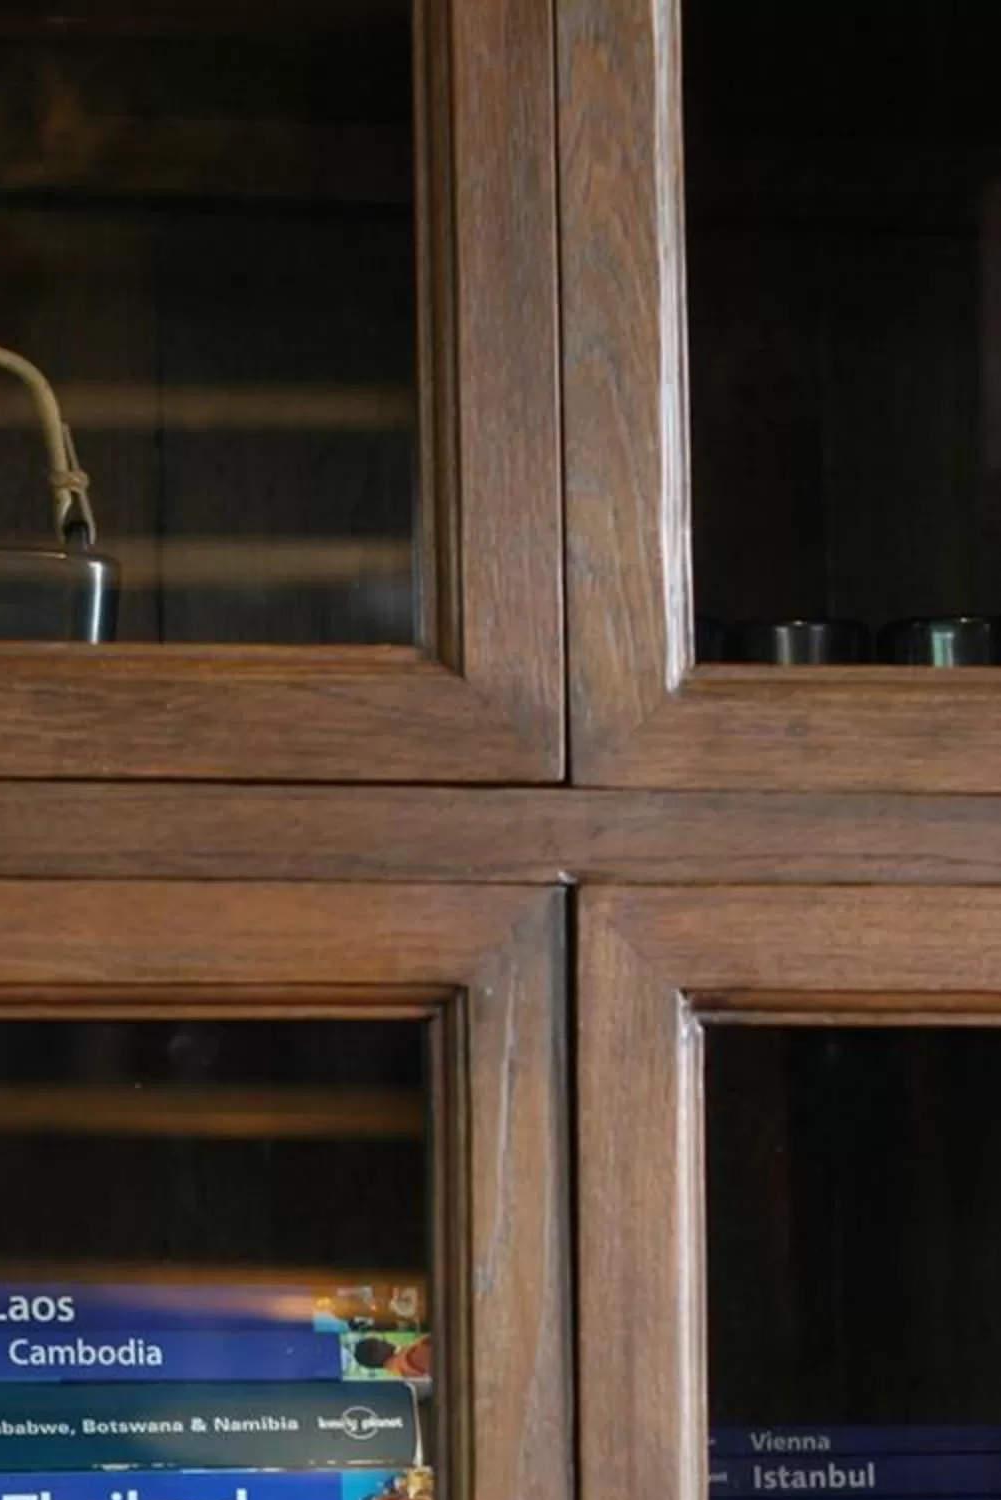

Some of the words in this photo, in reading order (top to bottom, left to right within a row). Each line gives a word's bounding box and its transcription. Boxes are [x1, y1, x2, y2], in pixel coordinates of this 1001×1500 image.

[9, 1338, 163, 1367] Cambodia
[82, 1417, 184, 1435] Botswana
[190, 1416, 207, 1433] &
[214, 1415, 299, 1432] Namibia
[317, 1416, 358, 1432] lonely
[360, 1415, 403, 1430] planet
[749, 1431, 831, 1452] Vienna
[753, 1461, 875, 1489] Istanbul
